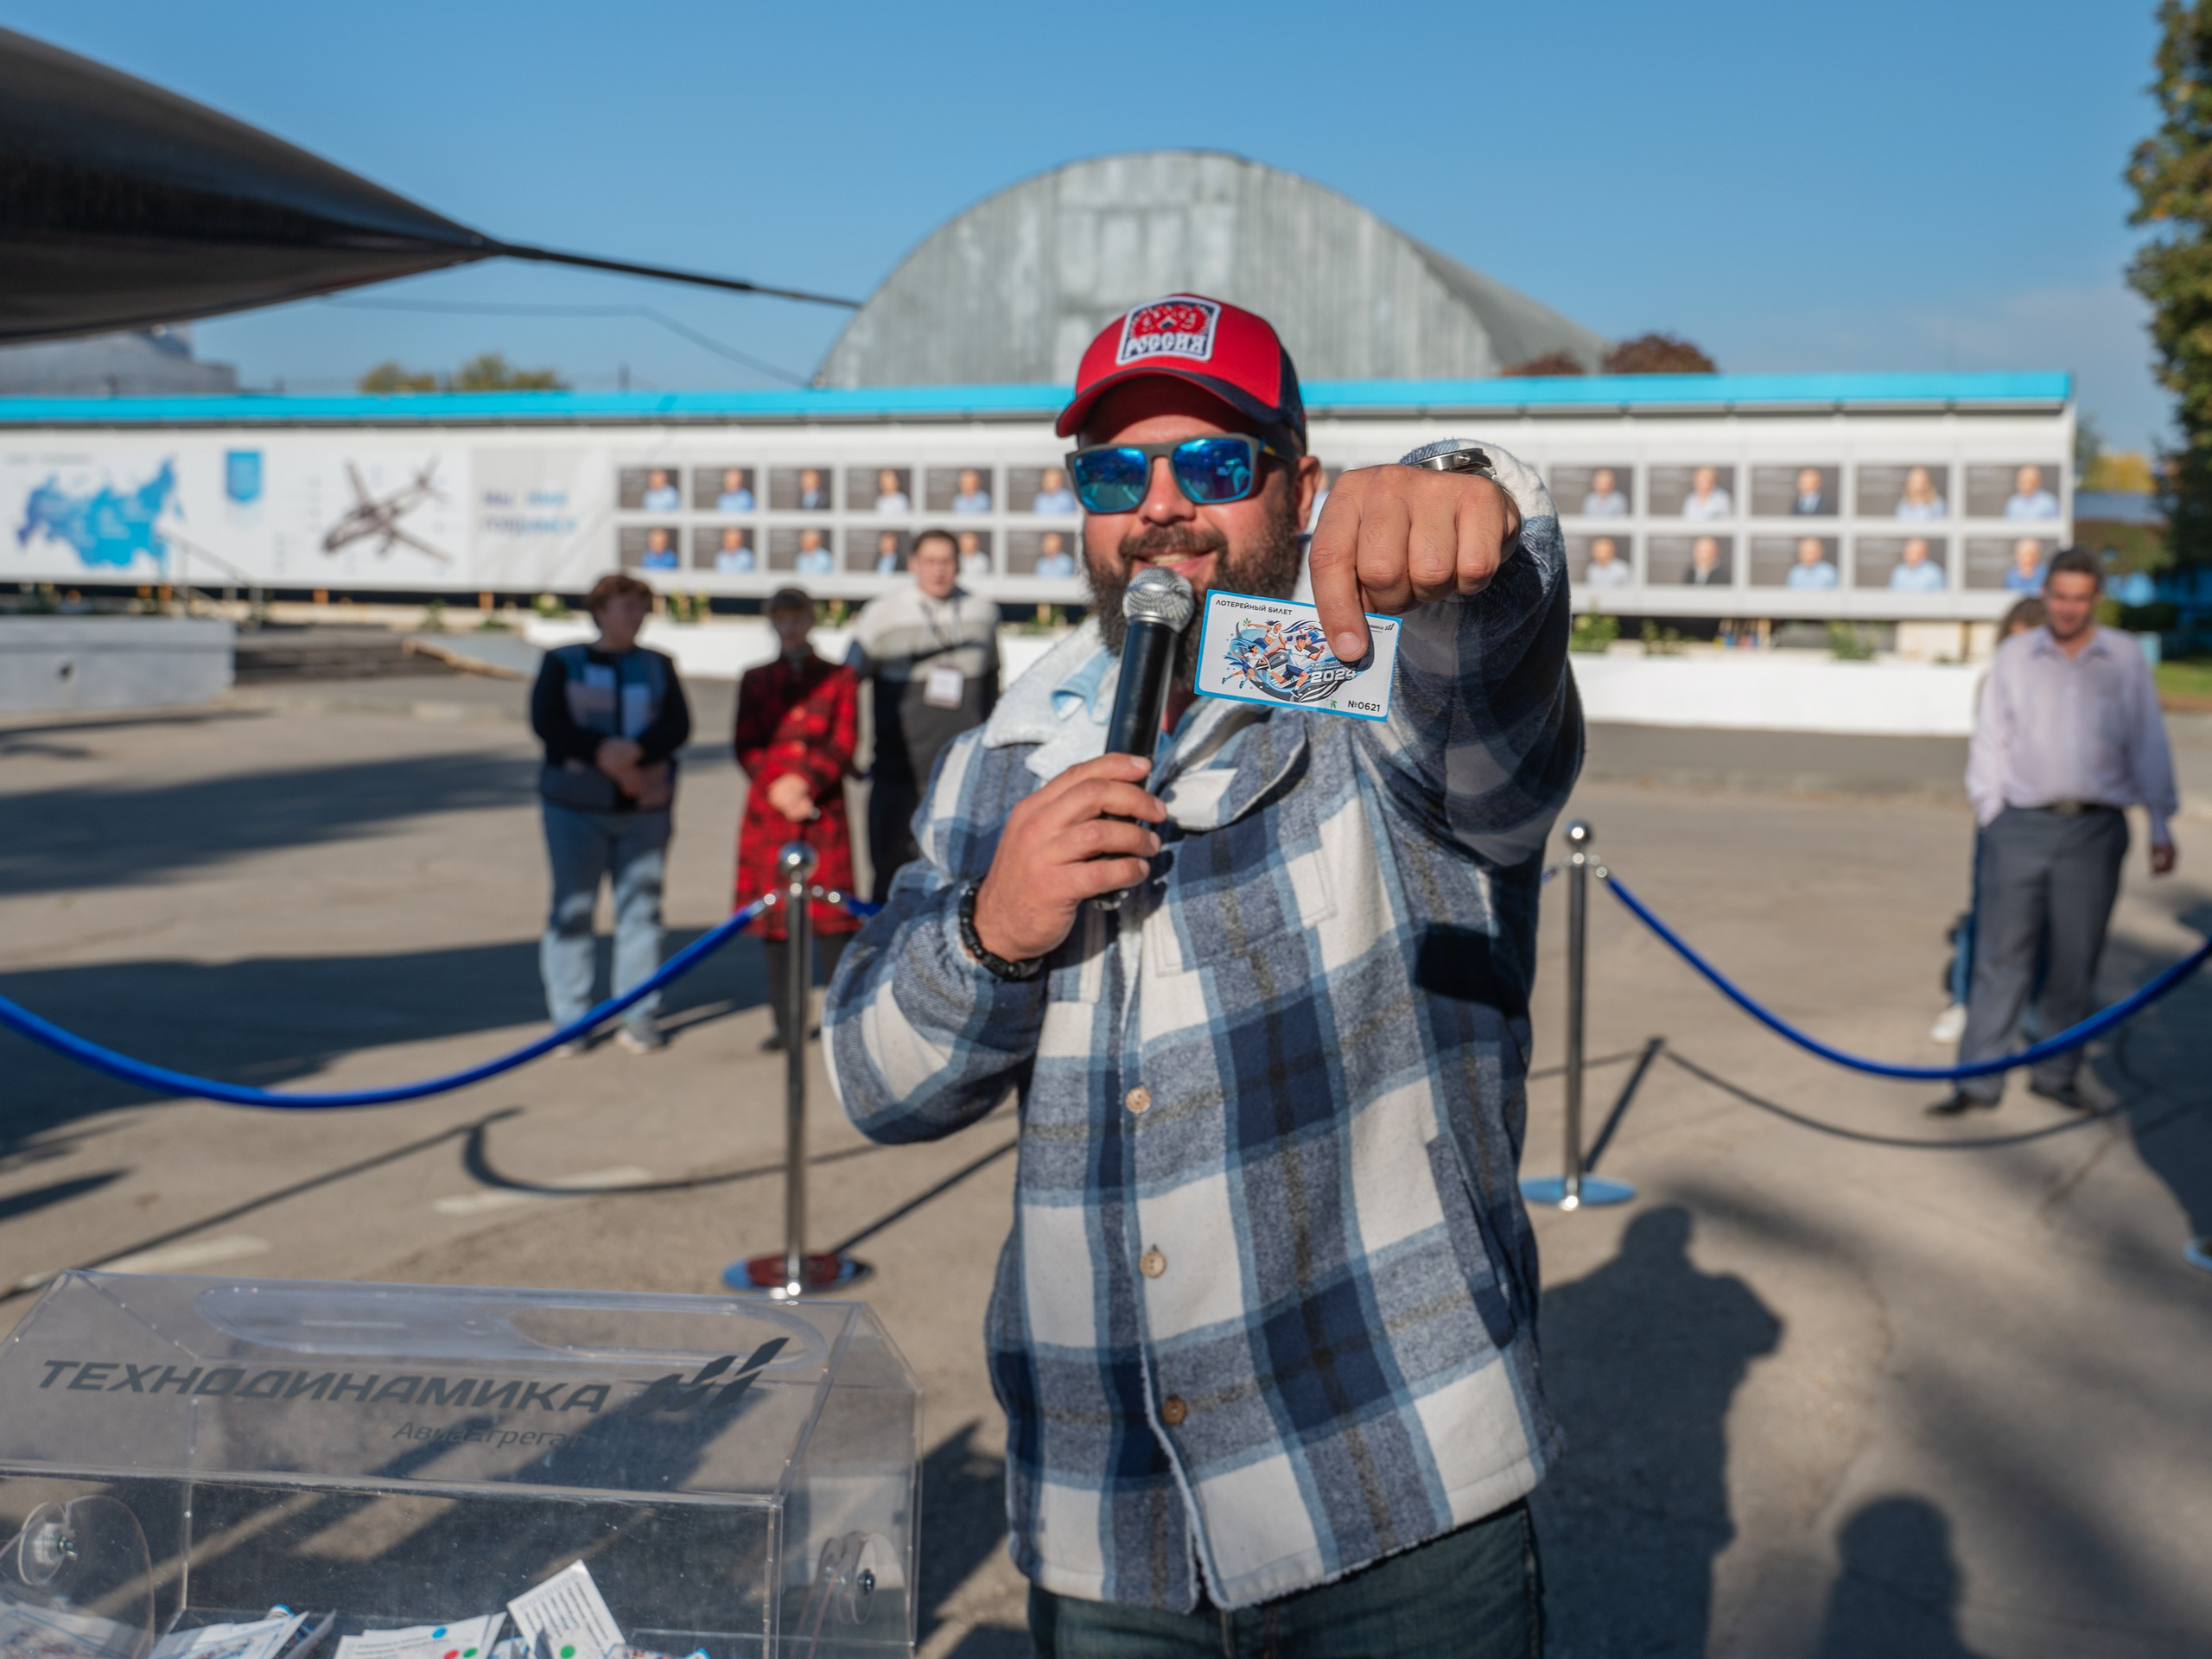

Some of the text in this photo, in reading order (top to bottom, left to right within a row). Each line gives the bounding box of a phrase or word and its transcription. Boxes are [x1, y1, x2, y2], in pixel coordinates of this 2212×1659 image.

[1123, 332, 1206, 357] РОССИЯ
[1215, 600, 1293, 615] ЛОТЕРЕЙНЫЙ БИЛЕТ
[1310, 668, 1357, 683] 2024
[38, 1359, 612, 1414] ТЕХНОДИНАМИКА
